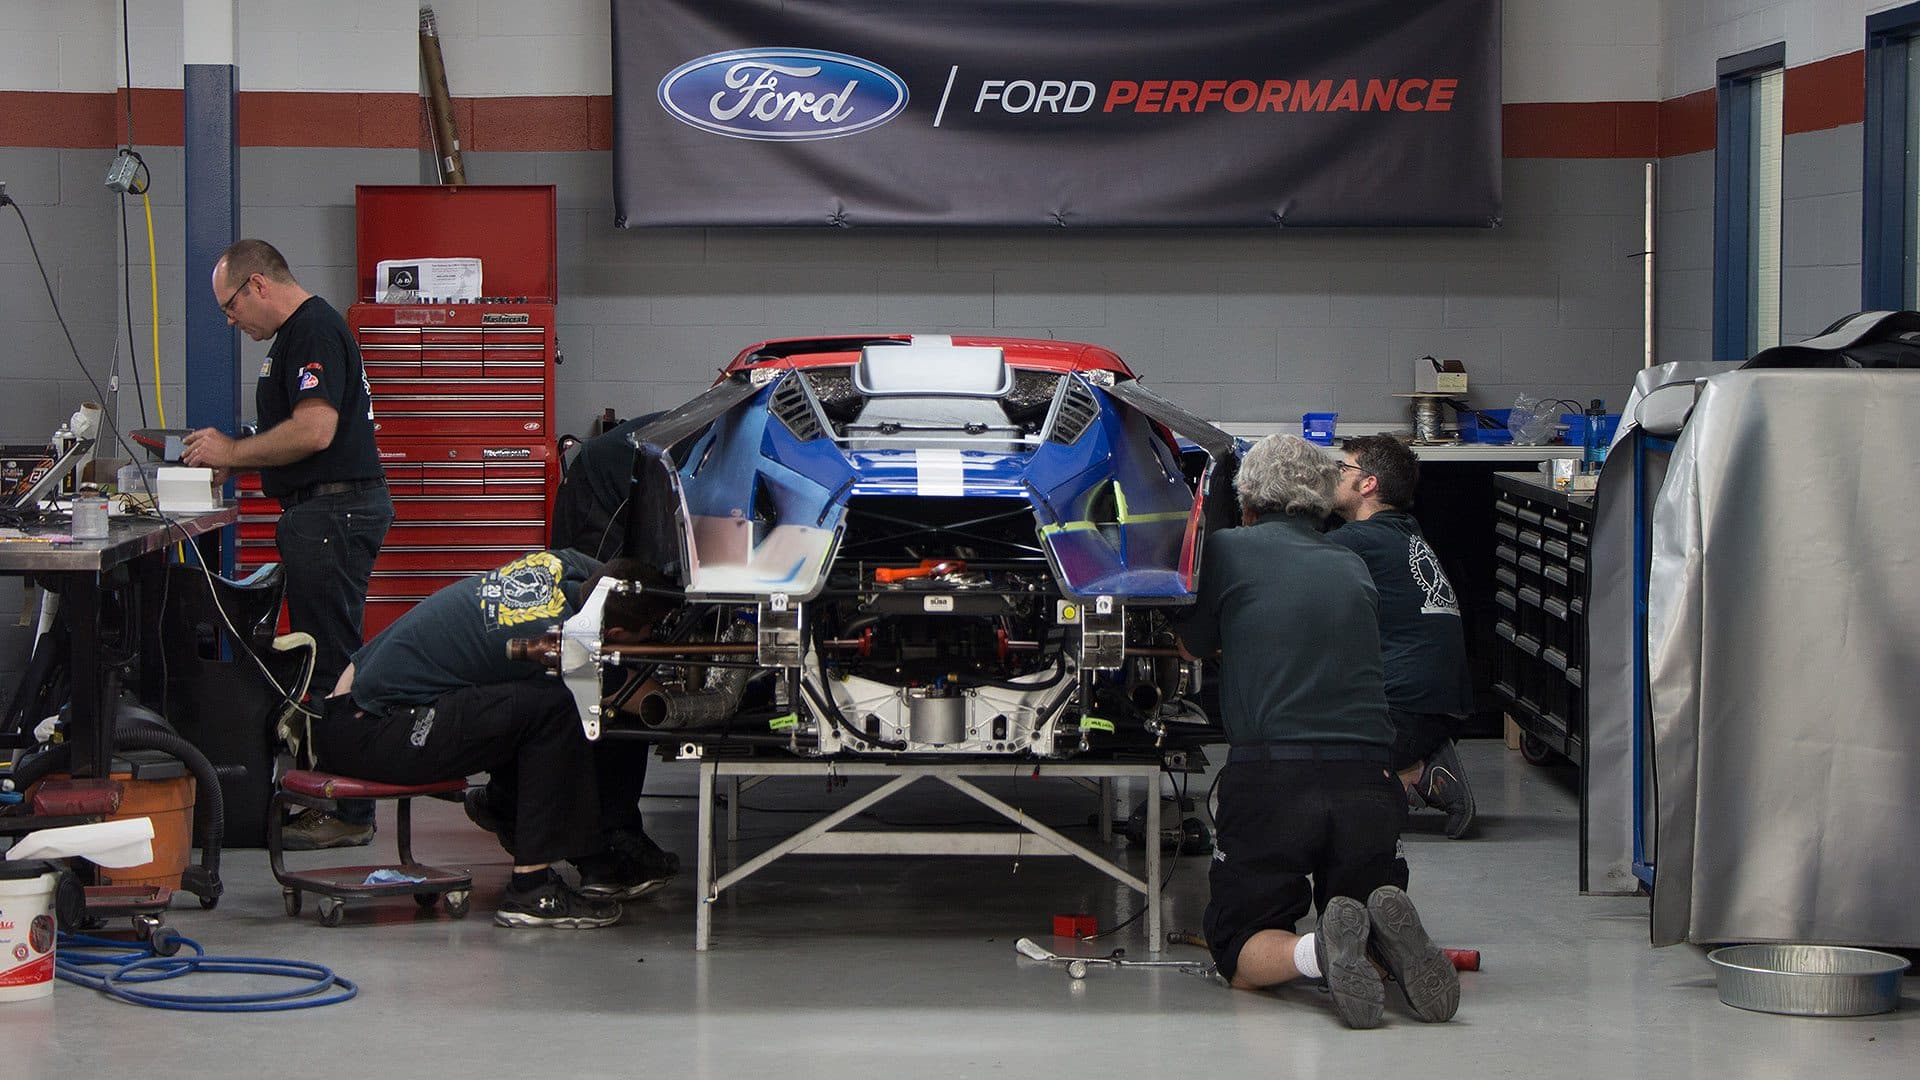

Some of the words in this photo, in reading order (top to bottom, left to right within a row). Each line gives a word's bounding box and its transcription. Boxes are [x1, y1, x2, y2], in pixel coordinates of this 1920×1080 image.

[709, 61, 859, 123] Ford
[974, 79, 1097, 114] FORD
[1102, 78, 1459, 114] PERFORMANCE
